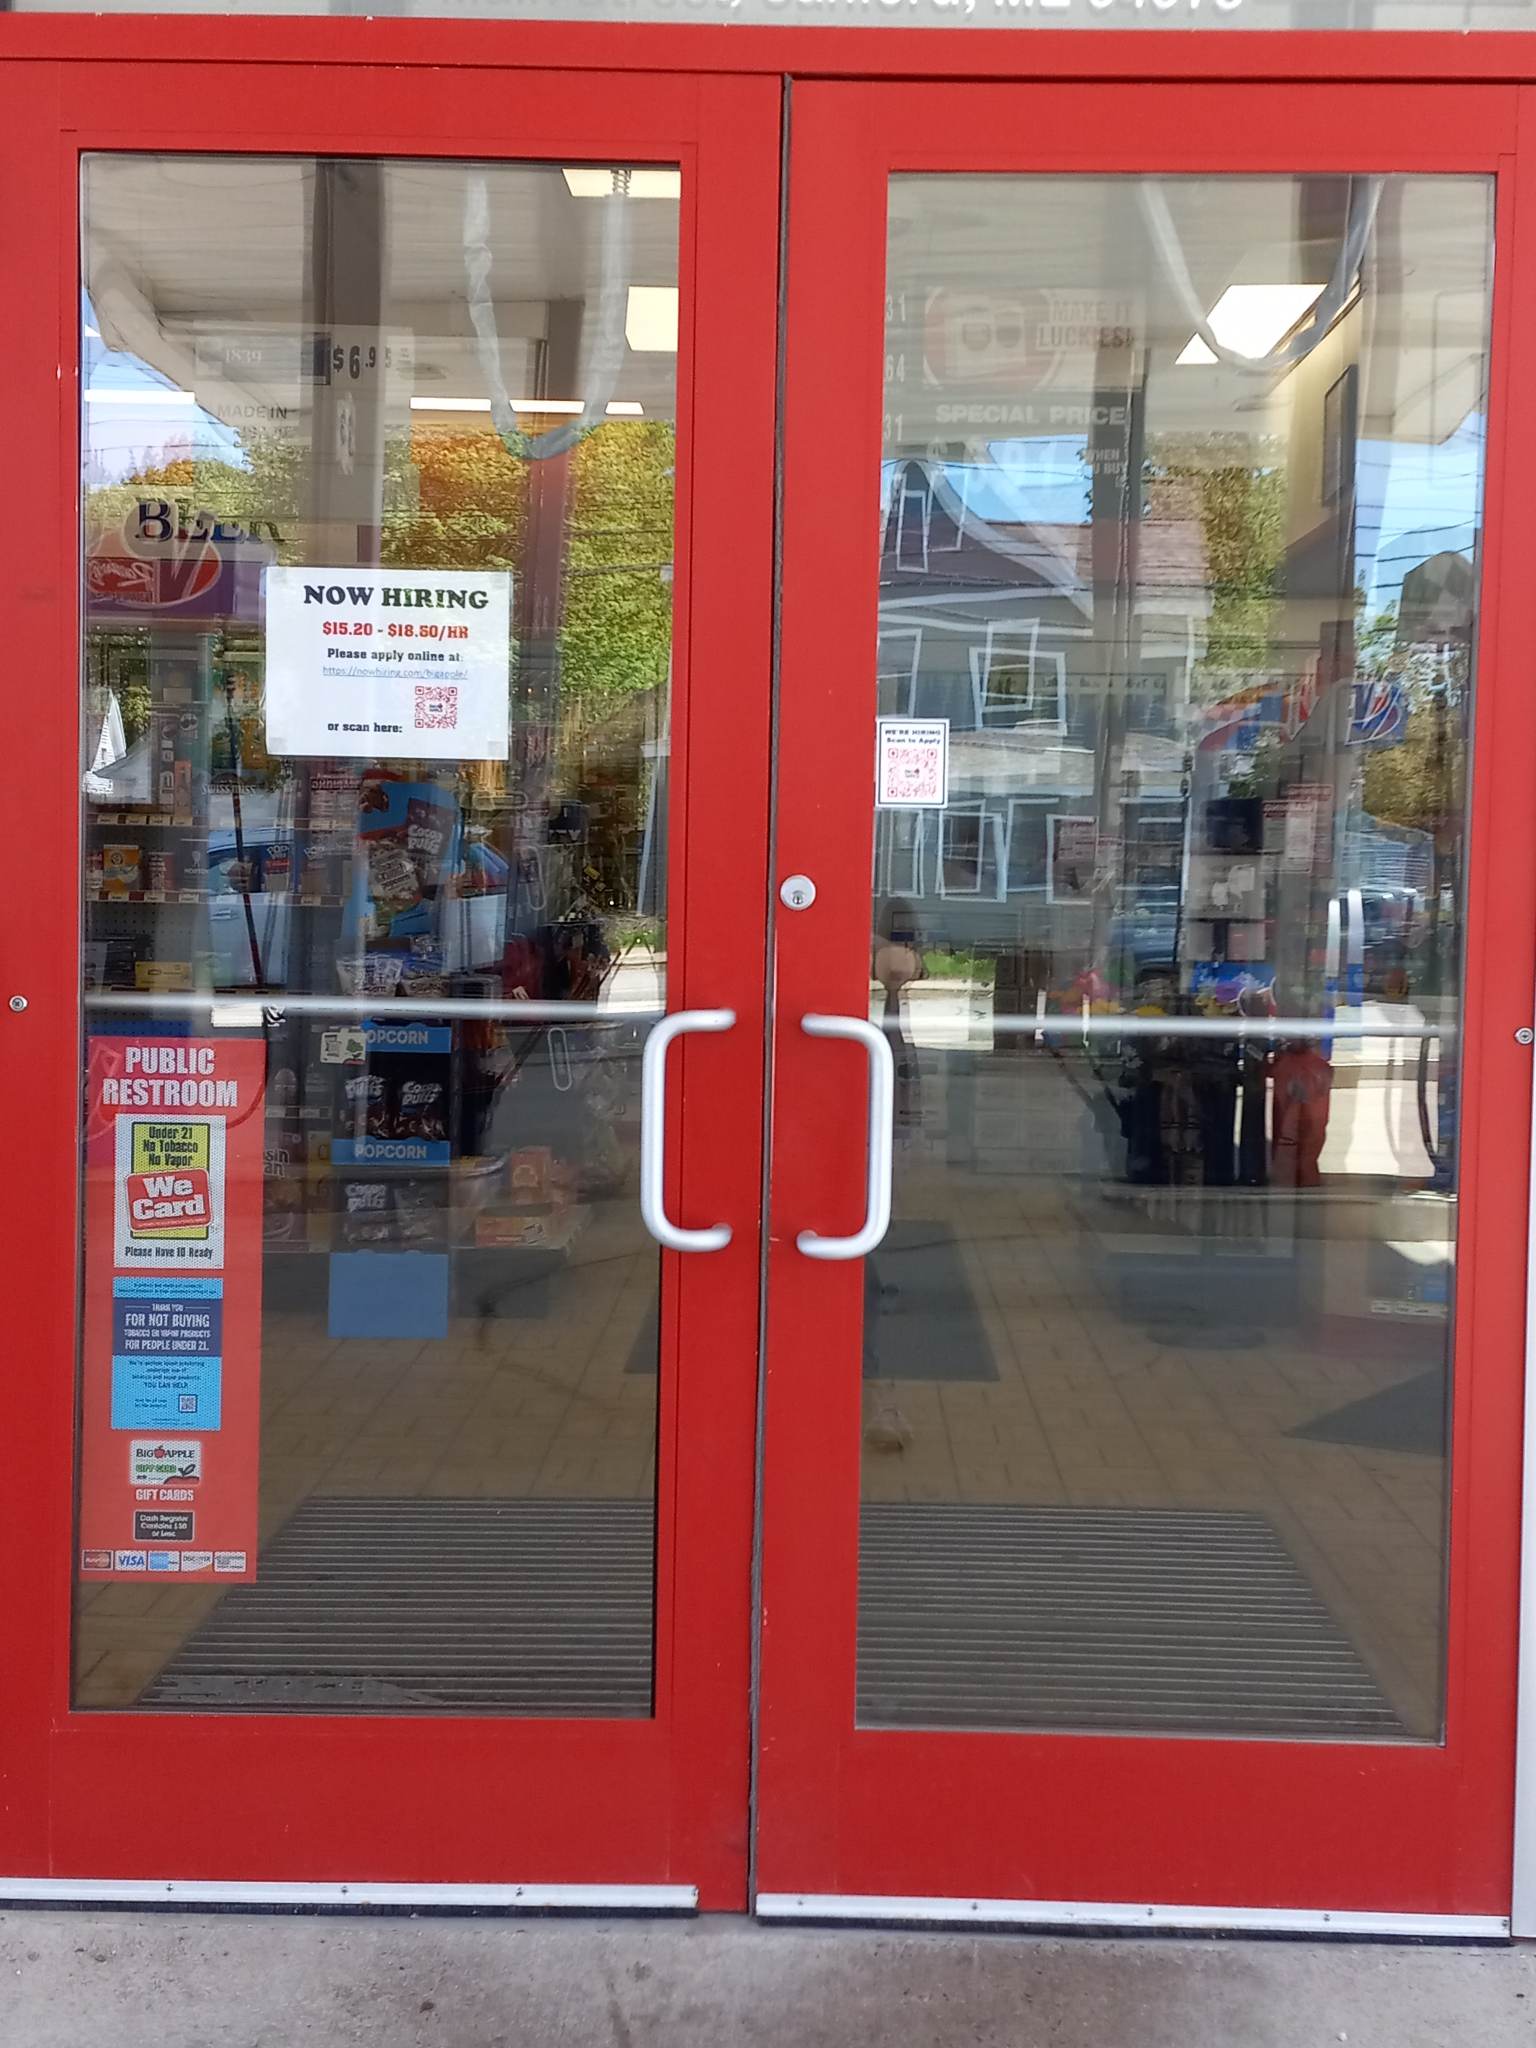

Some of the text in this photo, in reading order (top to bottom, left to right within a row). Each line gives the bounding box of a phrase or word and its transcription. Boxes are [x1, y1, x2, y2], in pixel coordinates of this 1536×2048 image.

[217, 405, 287, 419] MADE IN
[935, 405, 1127, 425] SPECIAL PRICE
[134, 497, 283, 544] BEER
[303, 585, 489, 609] NOW HIRING
[322, 621, 373, 636] $15.20
[327, 648, 367, 659] Please
[371, 650, 404, 662] apply
[407, 650, 444, 662] online
[327, 722, 402, 733] or scan here:
[366, 1030, 429, 1044] OPCORN
[125, 1046, 215, 1075] PUBLIC
[102, 1078, 238, 1107] RESTROOM
[148, 1127, 192, 1139] Under 21
[143, 1140, 198, 1152] No Tobacco
[355, 1146, 427, 1159] POPCORN
[148, 1154, 193, 1167] No Vapor
[142, 1175, 194, 1198] We
[133, 1193, 205, 1220] Card
[124, 1246, 213, 1259] Please Have ID Ready
[151, 1303, 171, 1311] THANK
[125, 1313, 210, 1327] FOR NOT BUYING
[125, 1339, 140, 1350] FOR
[141, 1340, 170, 1350] PEOPLE
[171, 1340, 196, 1350] UNDER
[165, 1449, 195, 1458] APPLE
[135, 1488, 194, 1501] GIFT CARDS
[118, 1555, 145, 1567] VISA
